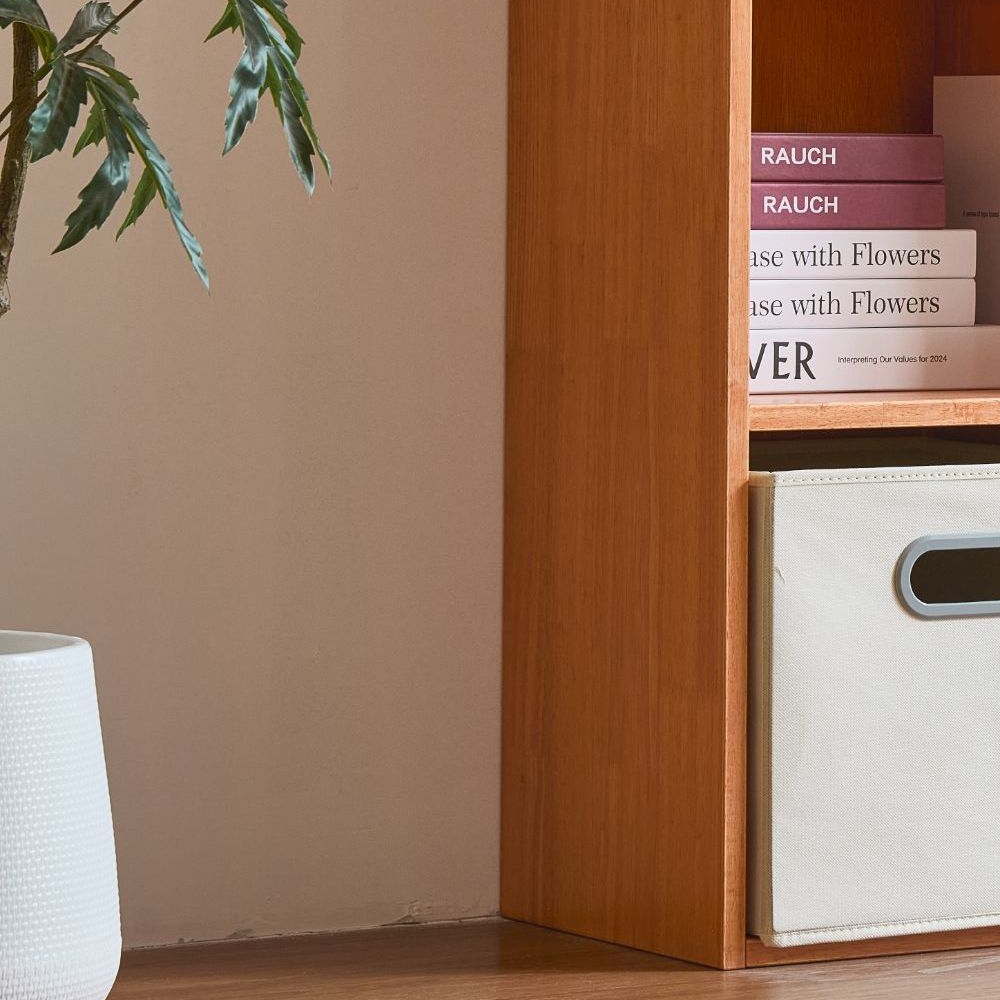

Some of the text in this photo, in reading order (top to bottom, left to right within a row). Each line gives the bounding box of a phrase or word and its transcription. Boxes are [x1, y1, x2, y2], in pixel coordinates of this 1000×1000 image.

[761, 147, 837, 165] RAUCH
[763, 196, 839, 214] RAUCH
[792, 242, 842, 267] with
[851, 242, 941, 267] Flowers
[791, 291, 841, 316] with
[851, 290, 940, 315] Flowers
[837, 354, 948, 365] Interpreting Our Values for 2024
